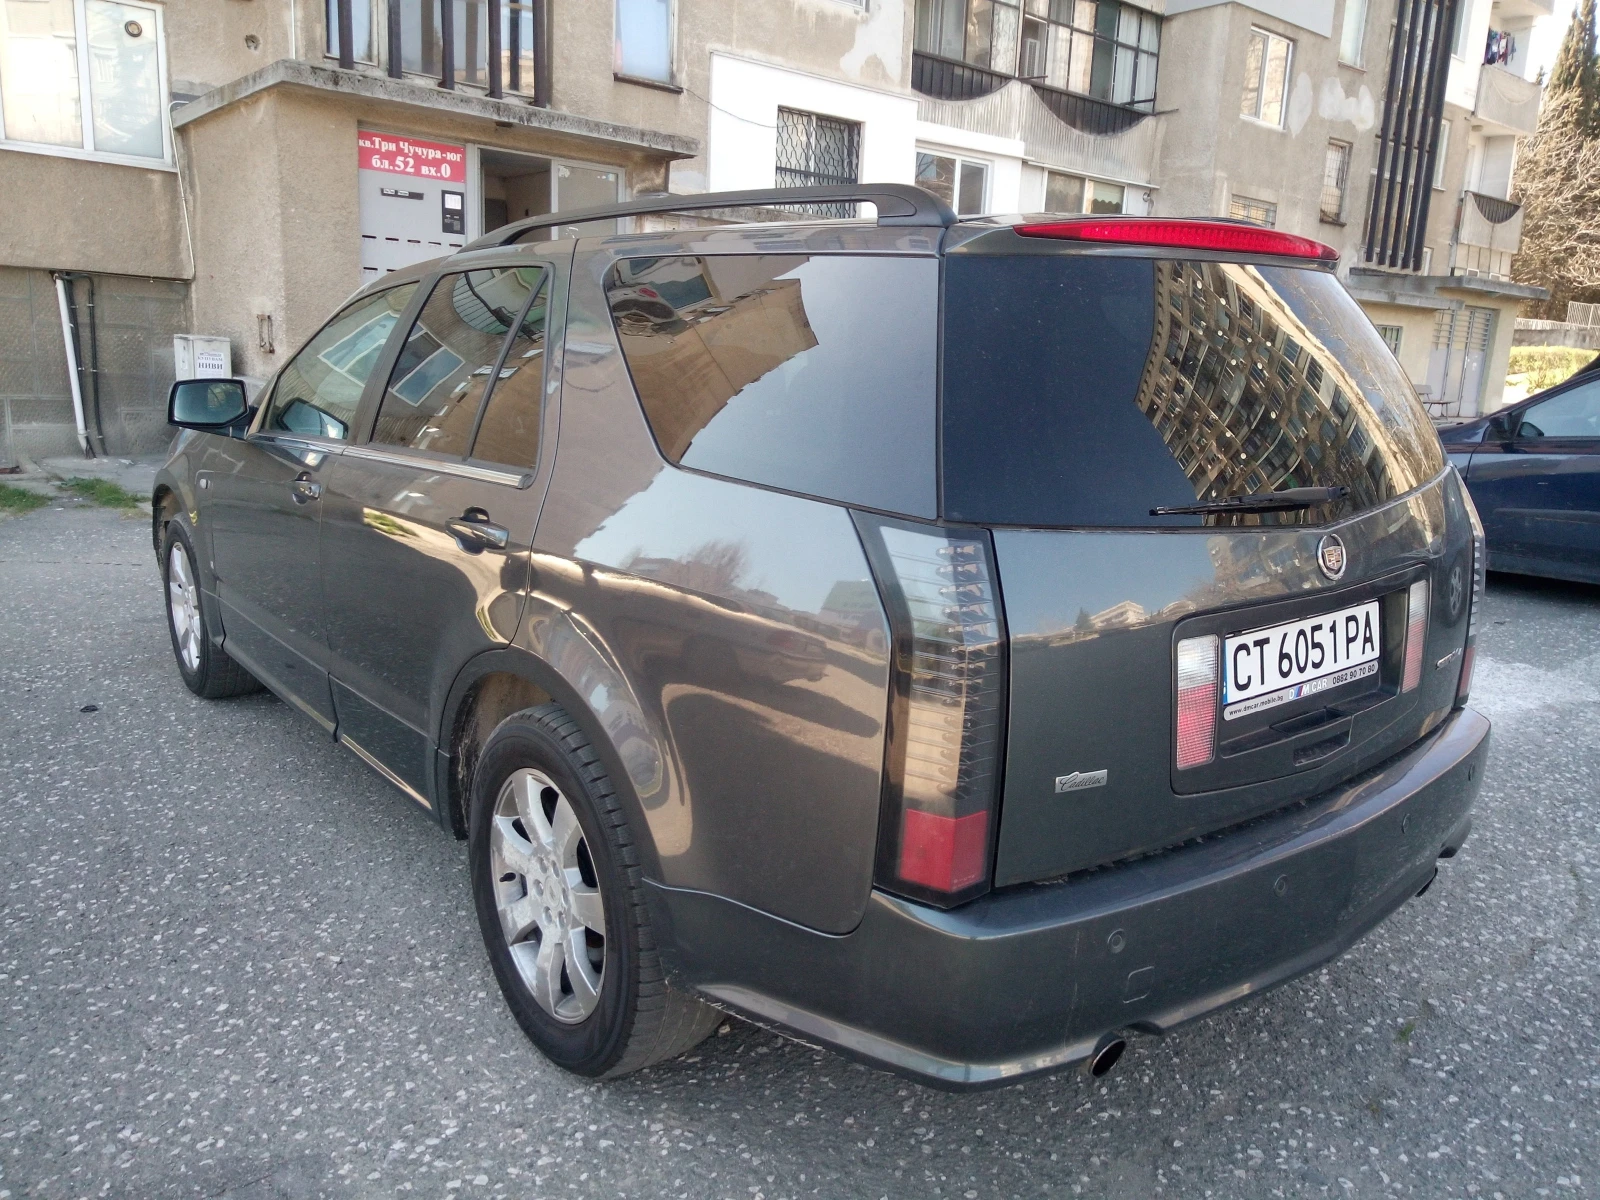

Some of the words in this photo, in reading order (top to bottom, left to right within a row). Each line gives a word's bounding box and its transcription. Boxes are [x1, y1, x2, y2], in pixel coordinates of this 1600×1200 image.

[399, 141, 462, 162] Чучура-юг
[371, 155, 415, 173] бл.52
[1233, 636, 1270, 692] CT
[1278, 619, 1338, 679] 6051
[1345, 610, 1375, 660] PA
[1311, 678, 1328, 692] CAR
[1059, 773, 1105, 791] Cadillac
